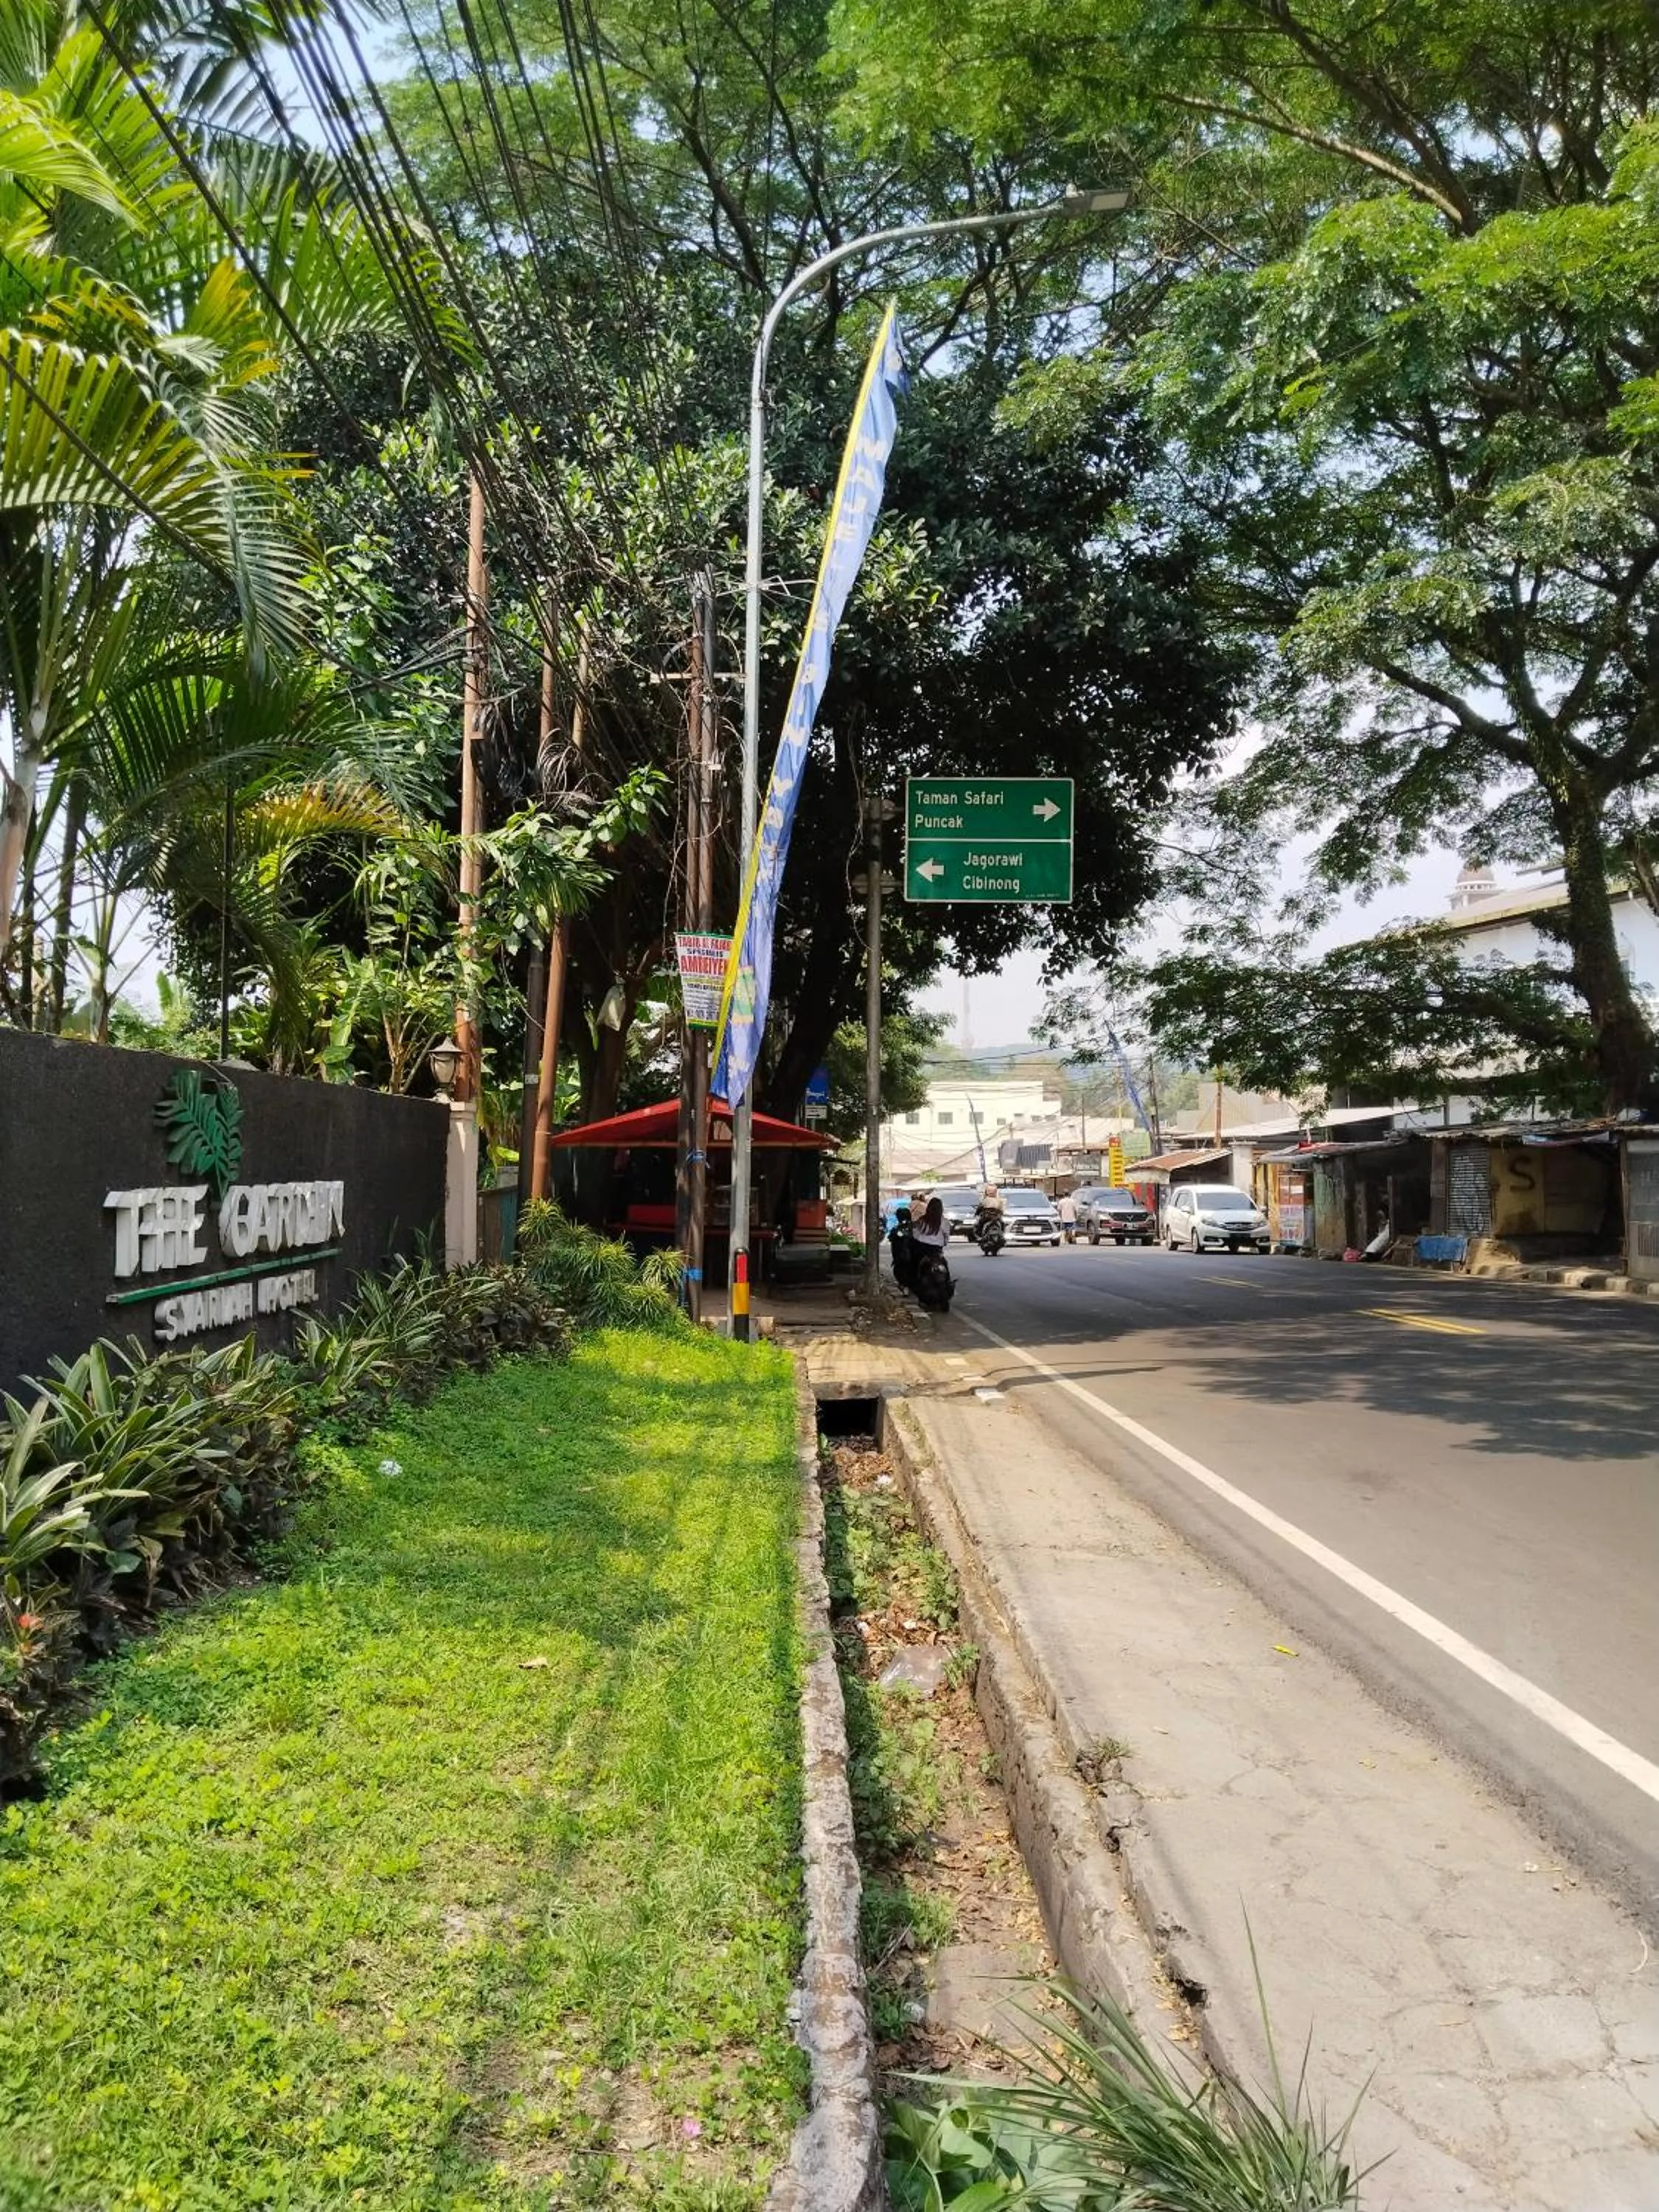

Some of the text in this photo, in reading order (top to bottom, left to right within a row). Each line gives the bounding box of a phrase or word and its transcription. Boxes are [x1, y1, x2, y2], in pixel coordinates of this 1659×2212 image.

[915, 790, 1004, 805] Taman Safari
[914, 813, 963, 829] Puncak
[963, 852, 1023, 870] Jagorawi
[962, 875, 1020, 894] Cibinong
[103, 1183, 209, 1279] THE
